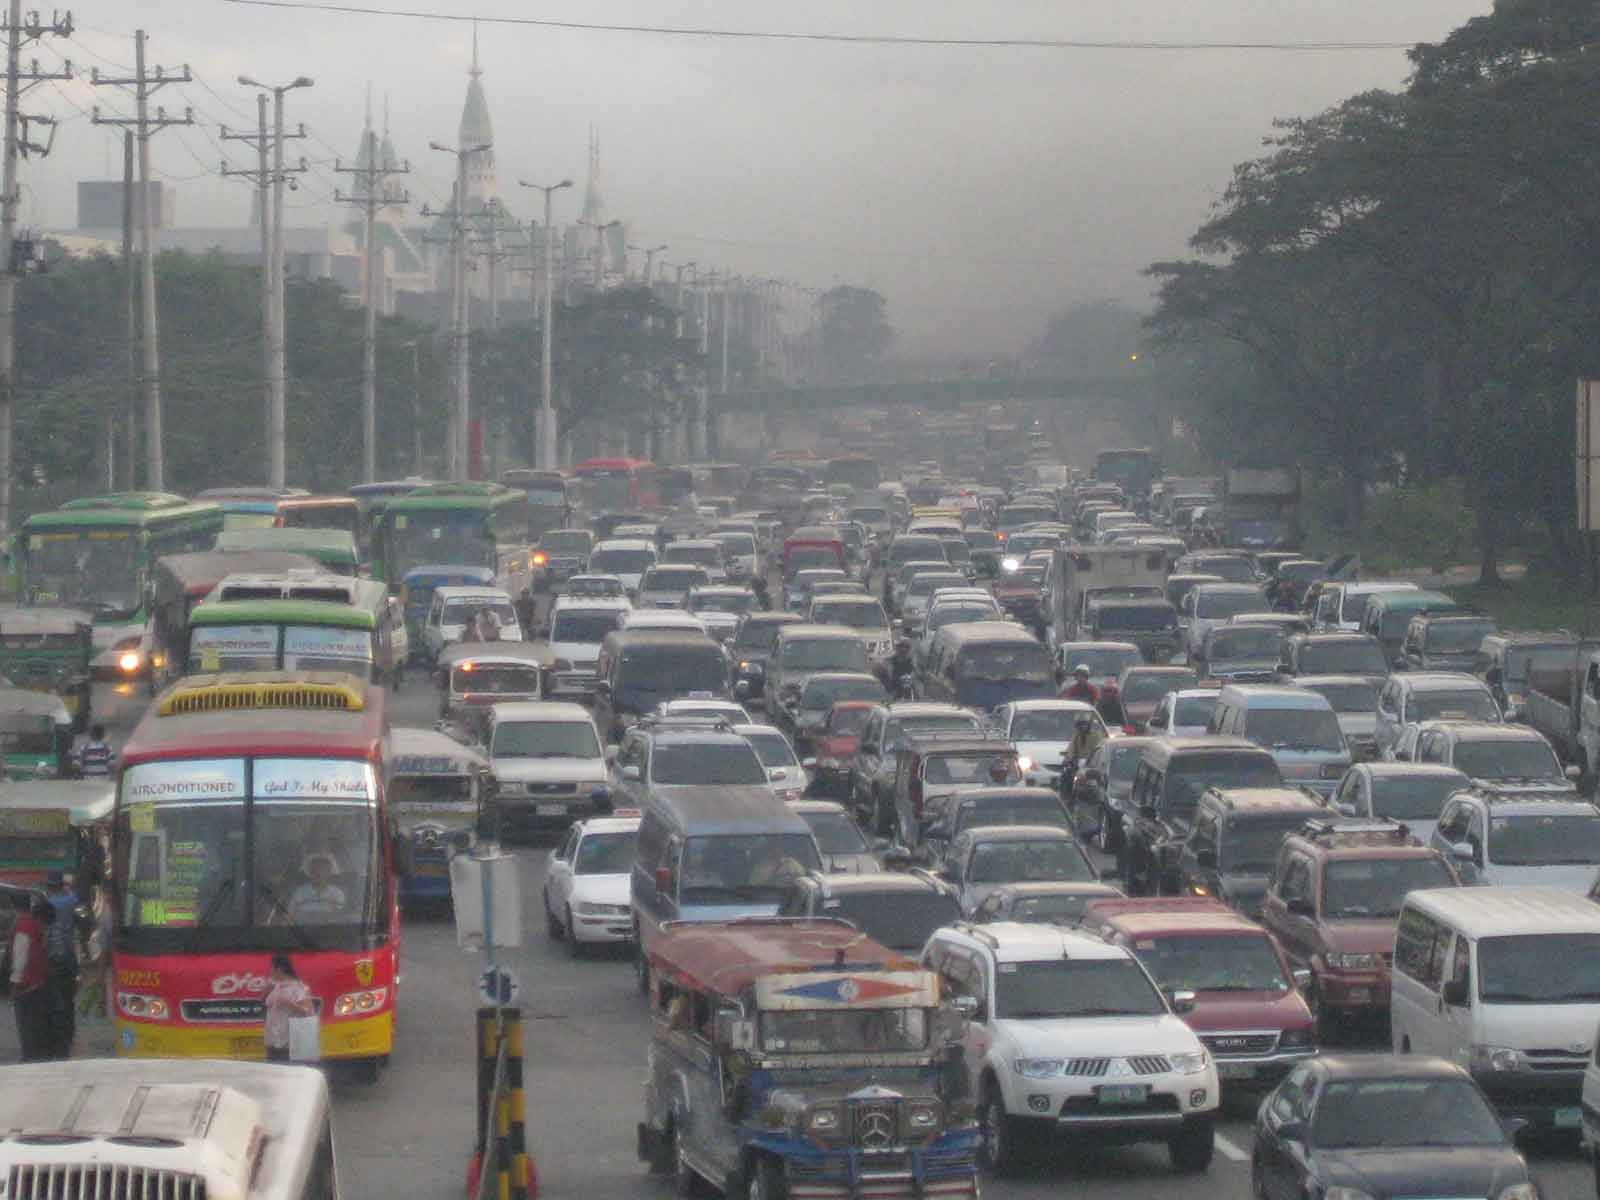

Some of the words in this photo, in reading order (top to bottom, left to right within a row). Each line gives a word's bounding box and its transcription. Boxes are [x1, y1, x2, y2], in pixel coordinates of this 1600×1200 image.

[131, 782, 237, 796] AIRCONDITIONED
[263, 780, 288, 794] God
[311, 779, 329, 794] My
